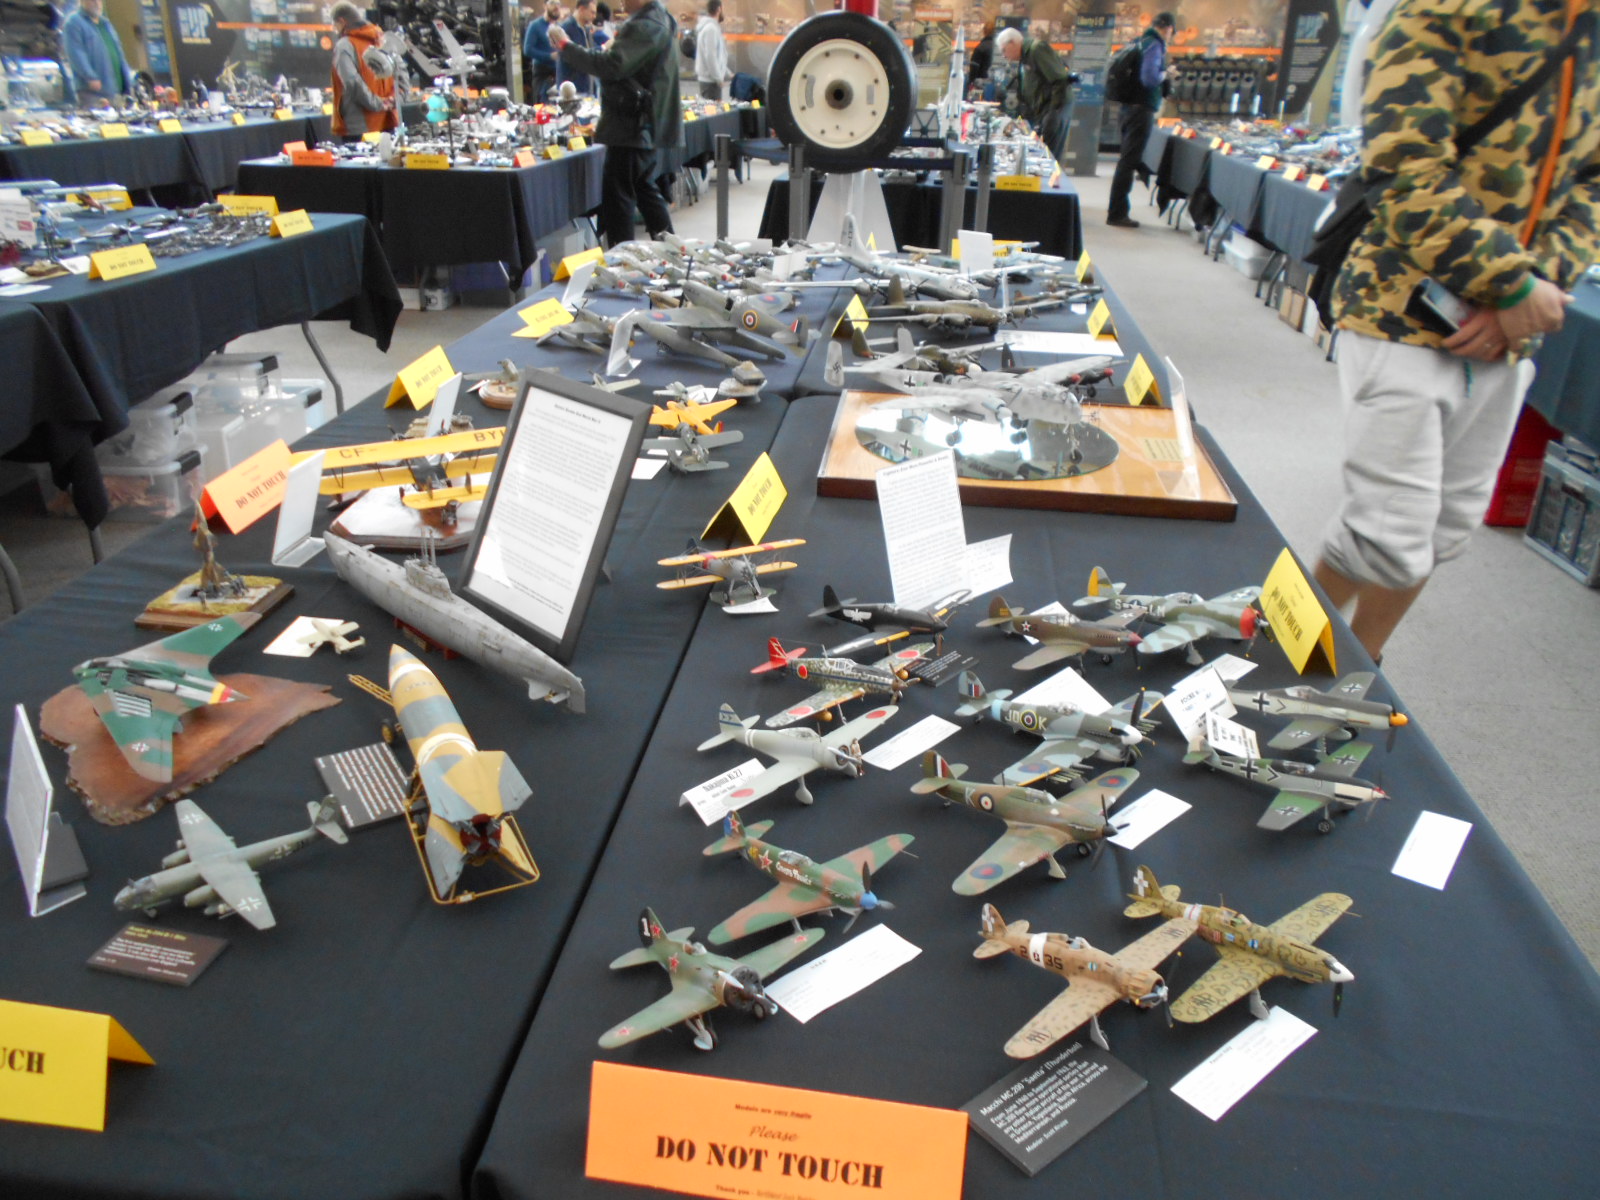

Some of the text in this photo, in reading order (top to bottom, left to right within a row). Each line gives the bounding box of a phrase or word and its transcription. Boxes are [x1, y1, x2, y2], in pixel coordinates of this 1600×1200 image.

[246, 485, 263, 501] NOT
[262, 469, 287, 491] TOUCH
[1038, 715, 1047, 731] K
[965, 787, 976, 808] K
[641, 917, 651, 937] 1
[1019, 945, 1029, 960] 2
[749, 1125, 798, 1143] Please
[655, 1135, 885, 1189] DO NOT TOUCH
